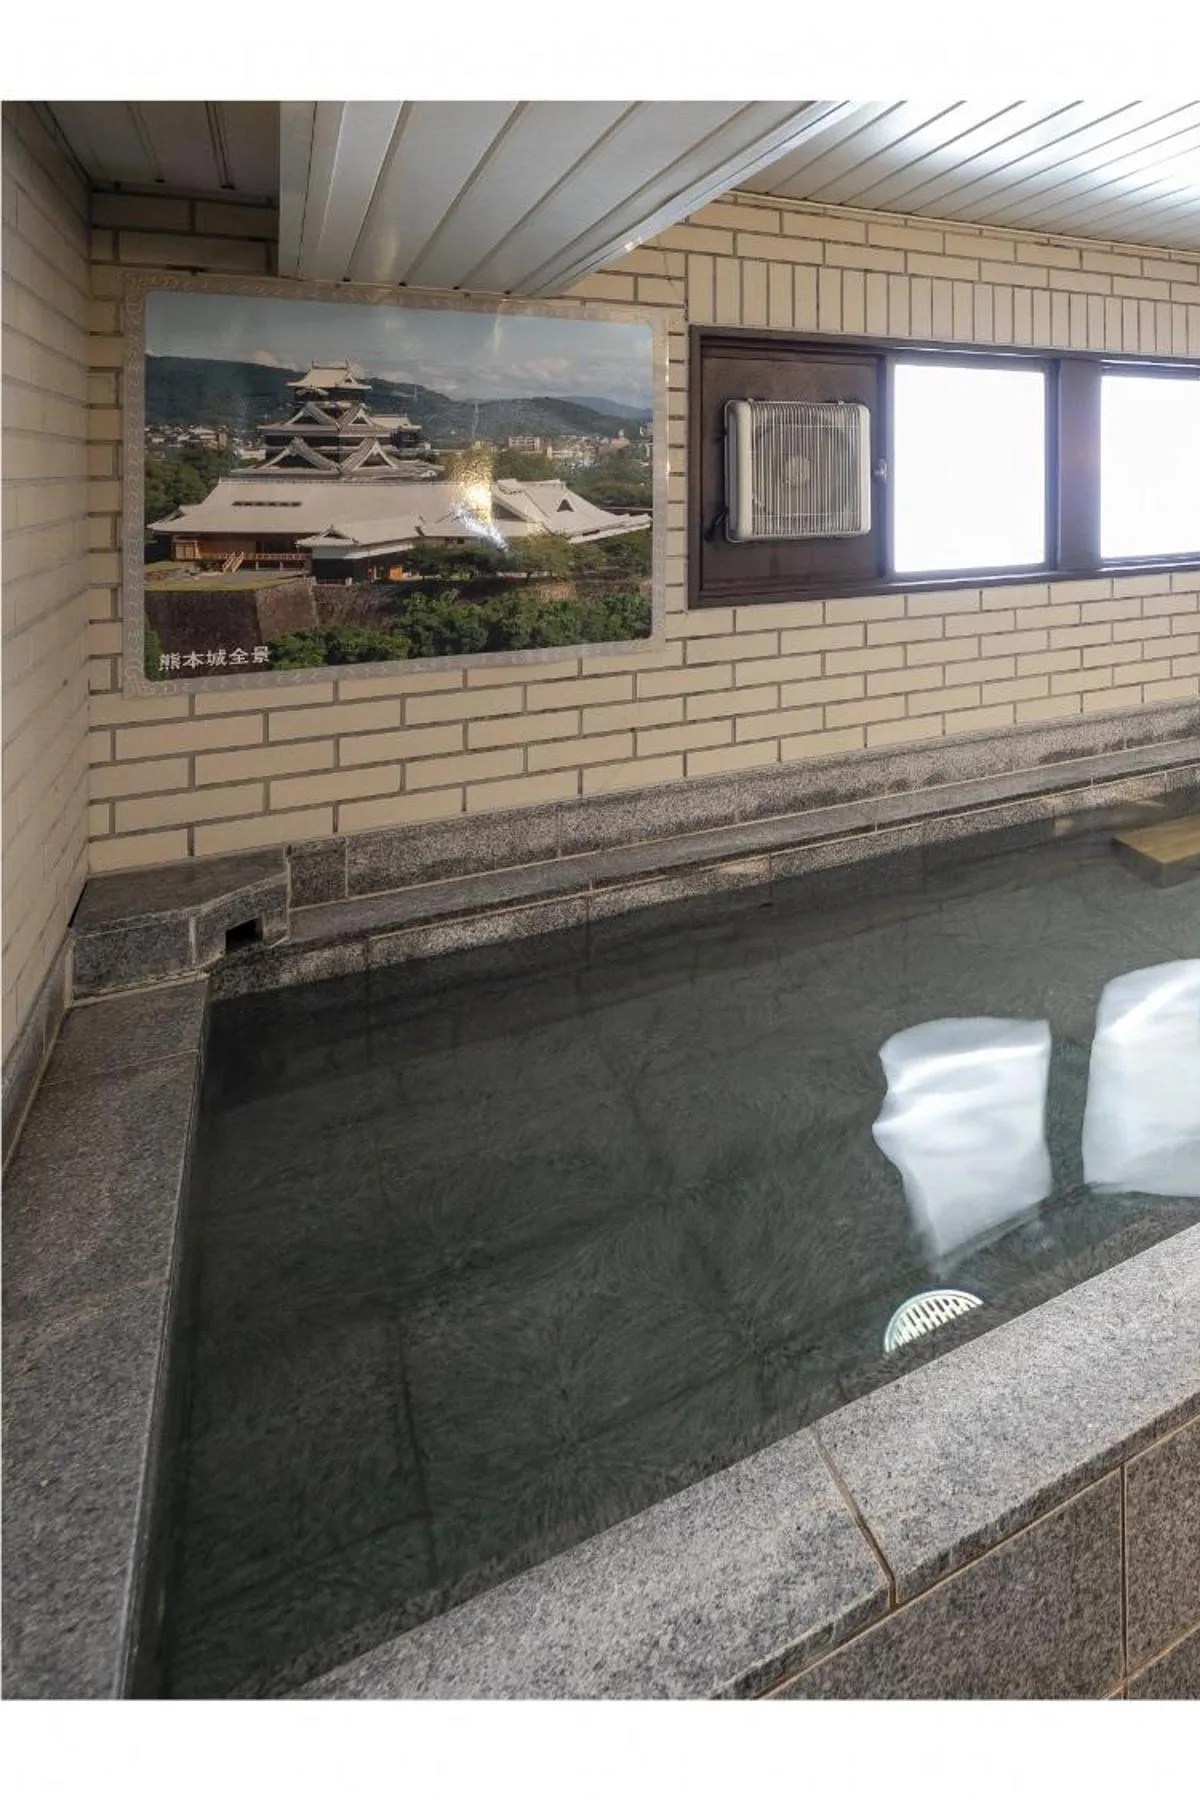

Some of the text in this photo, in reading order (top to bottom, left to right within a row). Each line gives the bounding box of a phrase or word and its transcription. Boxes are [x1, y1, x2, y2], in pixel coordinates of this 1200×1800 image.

[158, 645, 270, 671] 熊本城全景
